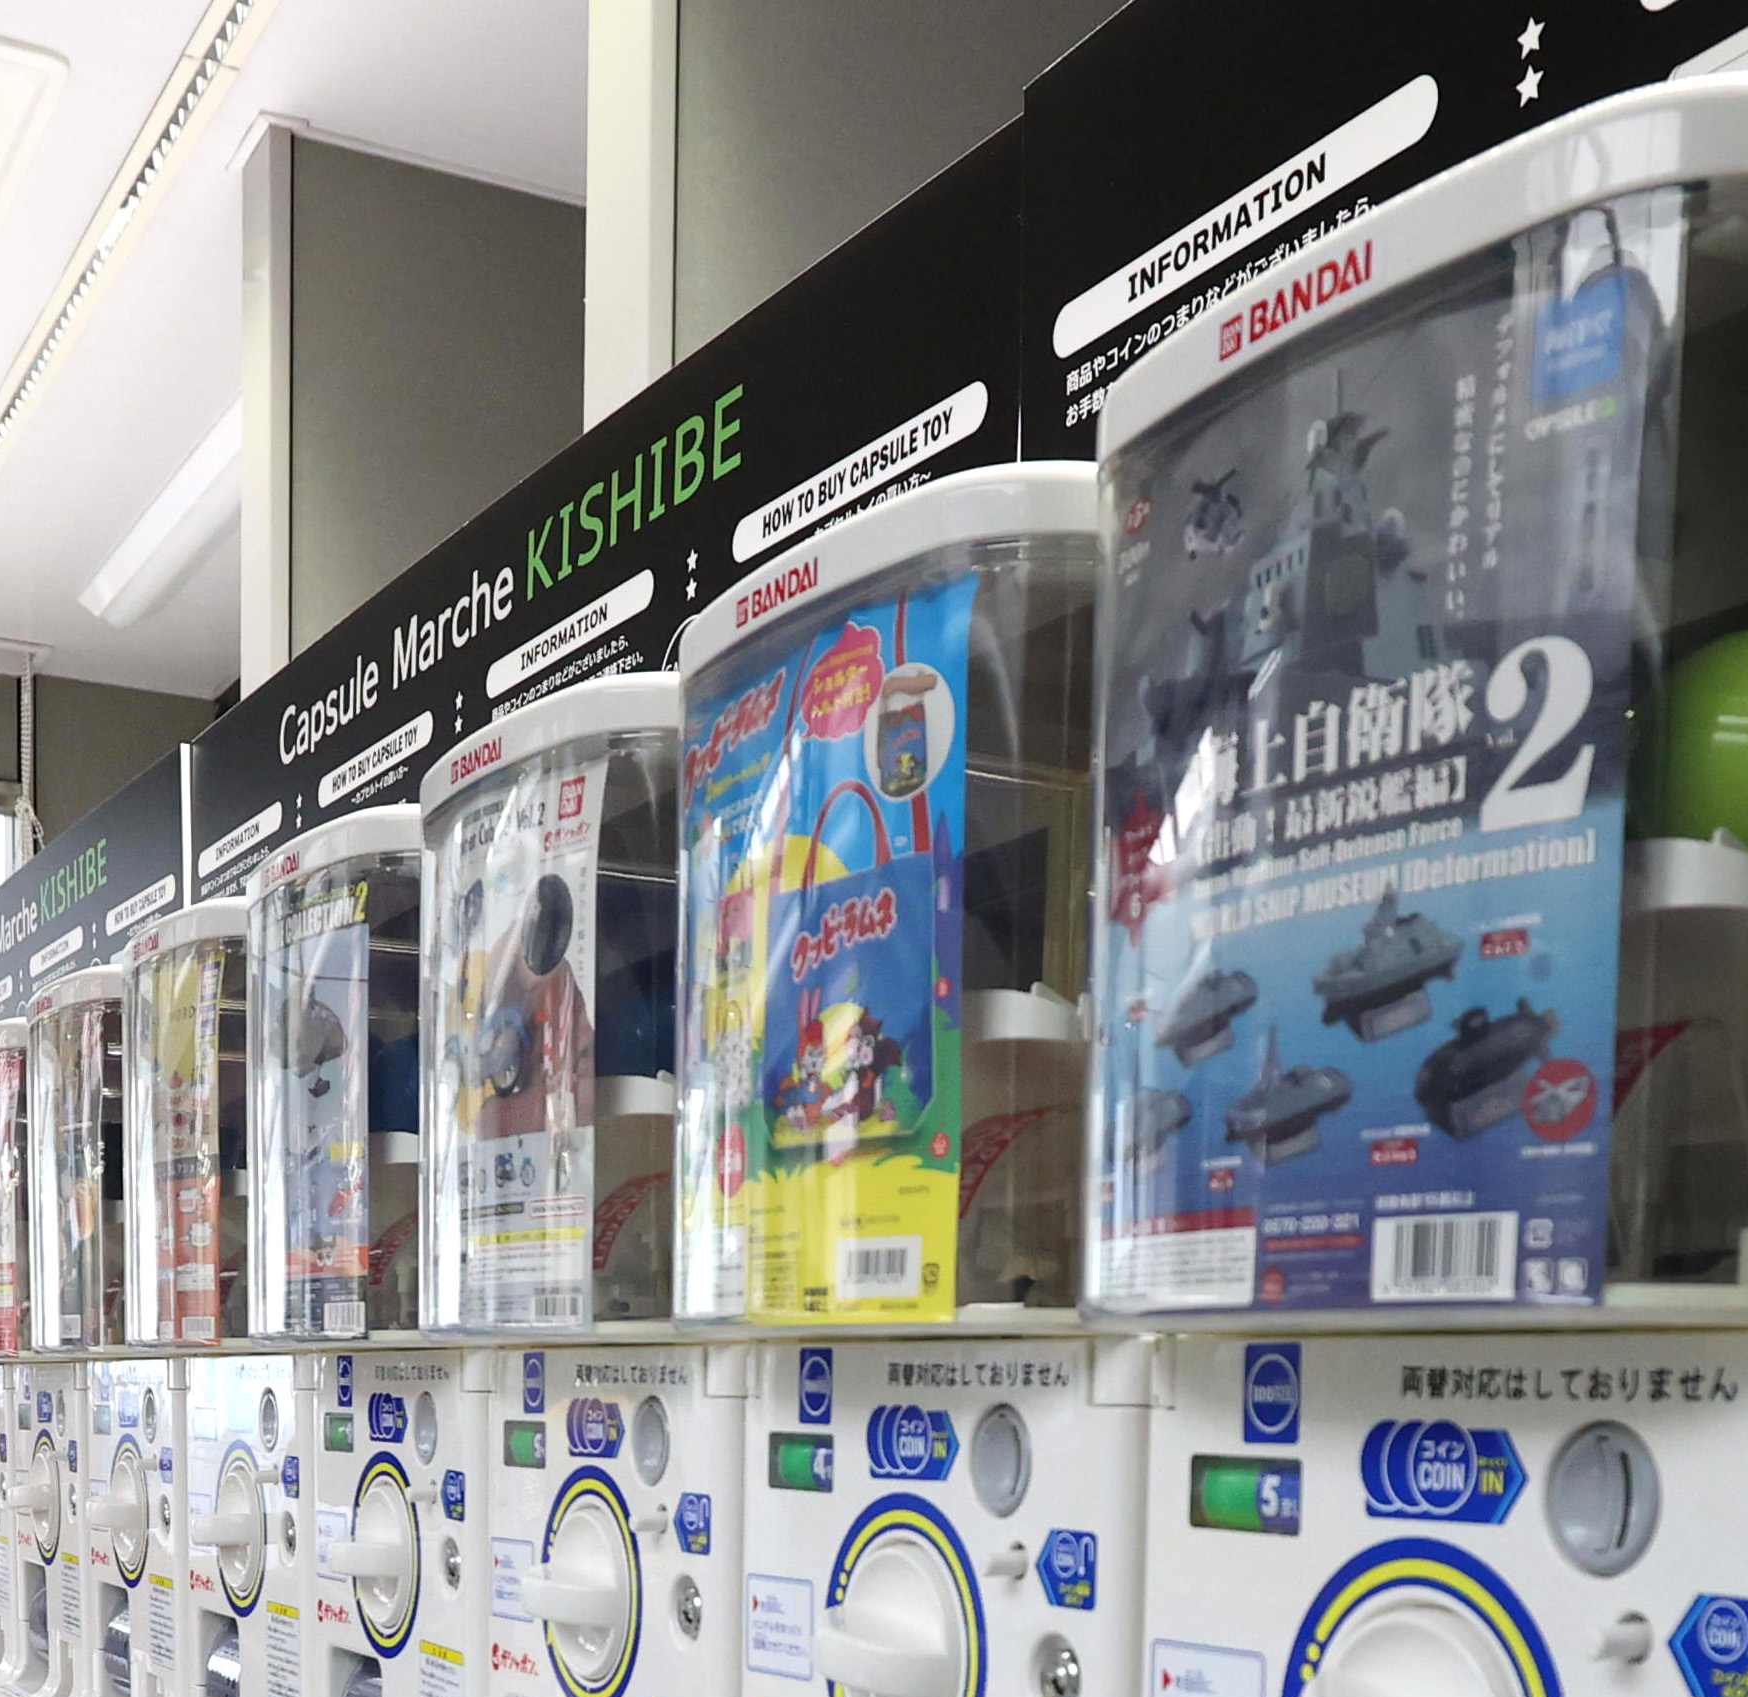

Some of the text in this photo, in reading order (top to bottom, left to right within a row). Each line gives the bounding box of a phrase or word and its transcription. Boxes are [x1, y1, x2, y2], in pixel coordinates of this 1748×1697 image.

[1128, 153, 1326, 302] INFORMATION
[1250, 240, 1373, 344] BANDAI
[762, 406, 953, 539] HOW TO BUY CAPSULE TOY
[279, 383, 743, 765] Capsule Marche KISHIBE
[752, 557, 818, 617] BANDAI
[521, 603, 608, 670] INFORMATION
[332, 725, 419, 793] HOW TO BUY CAPSULE TOY
[460, 736, 501, 779] BANDAI
[1480, 635, 1595, 833] 2
[215, 817, 260, 861] INFORMATION
[38, 838, 109, 926] KISHIBE
[285, 880, 368, 945] COLLECTION 2
[887, 1361, 1070, 1388] 両替対応はしておりません
[1401, 1364, 1739, 1403] 両替対応はしておりません
[1417, 1461, 1505, 1495] COIN IN
[1420, 1440, 1464, 1460] コイン
